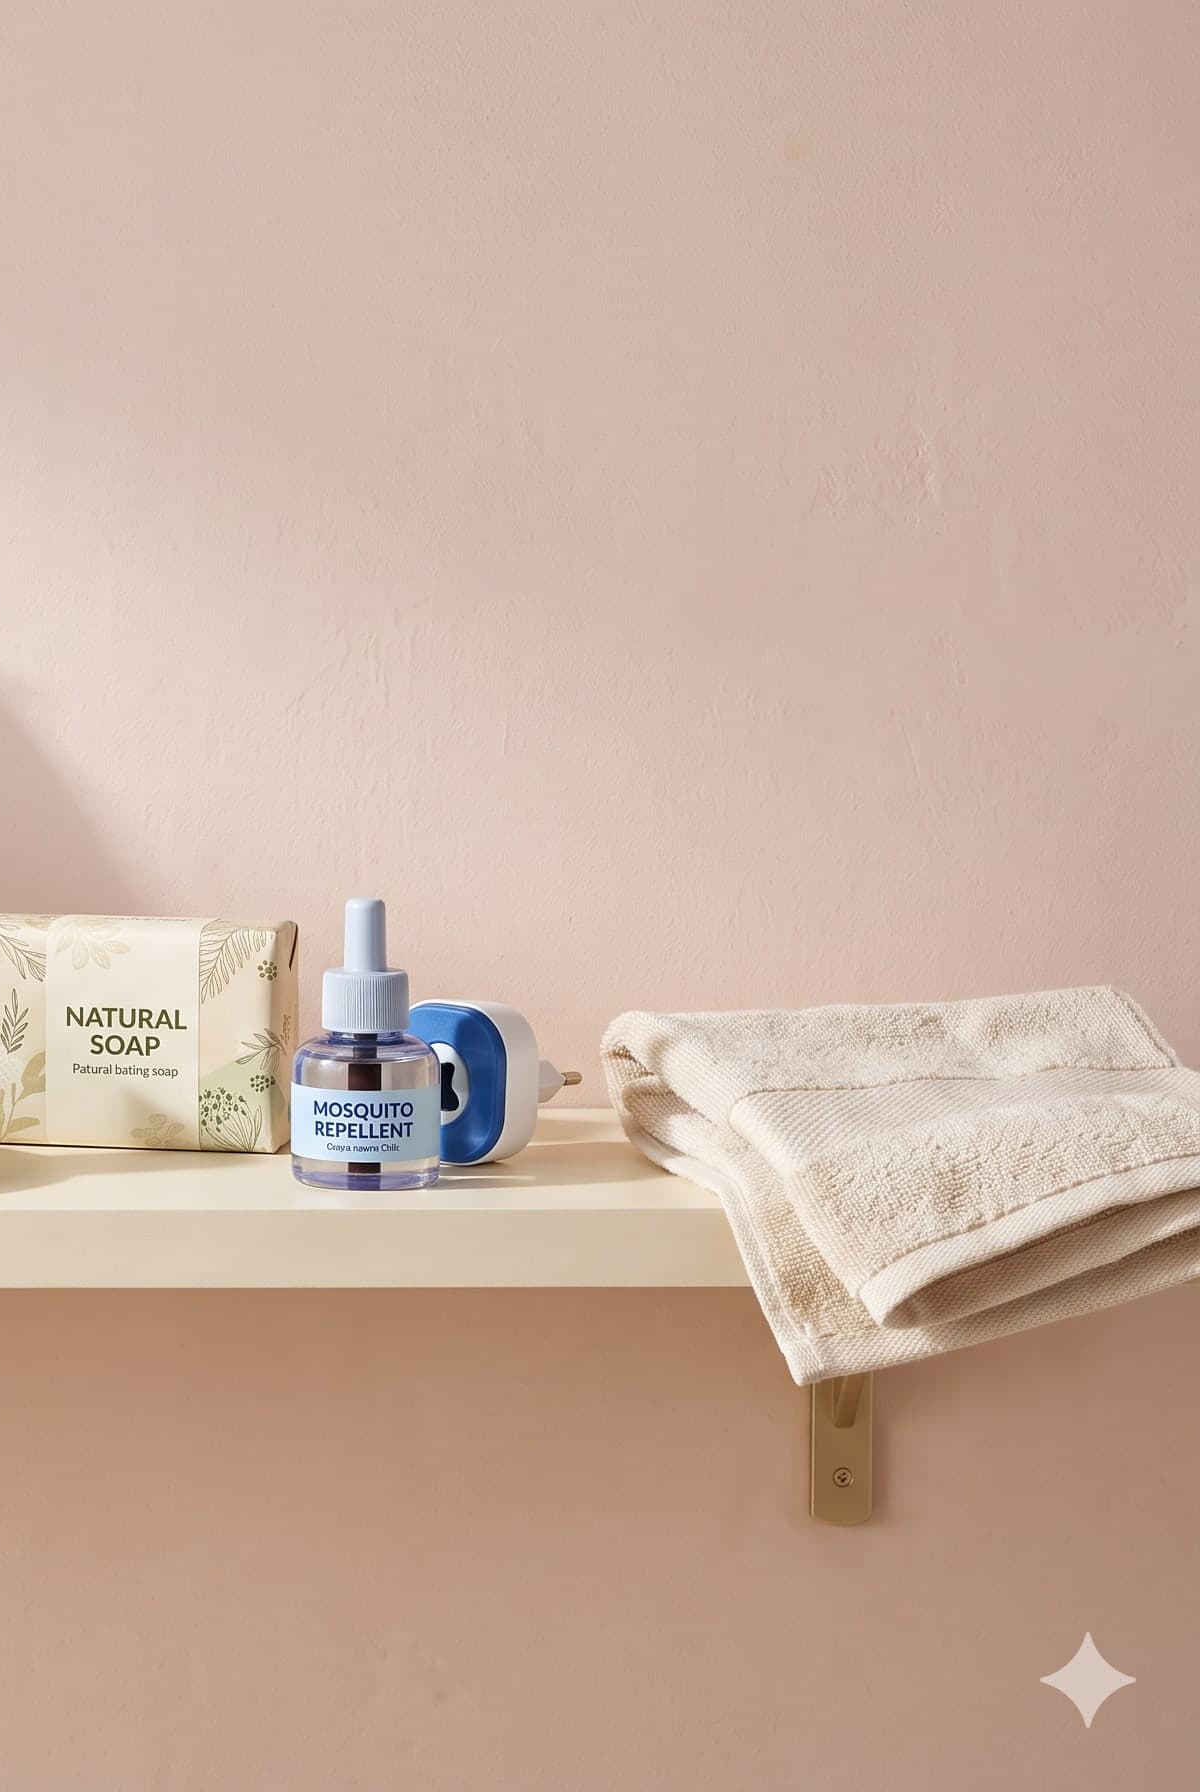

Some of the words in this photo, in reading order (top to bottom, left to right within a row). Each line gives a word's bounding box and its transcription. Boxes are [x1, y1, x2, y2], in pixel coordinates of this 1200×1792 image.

[66, 1006, 188, 1030] NATURAL
[89, 1034, 161, 1057] SOAP
[72, 1063, 113, 1076] Patural
[114, 1063, 150, 1079] bating
[152, 1067, 179, 1080] soap
[313, 1100, 414, 1121] MOSQUITO
[315, 1120, 414, 1139] REPELLENT
